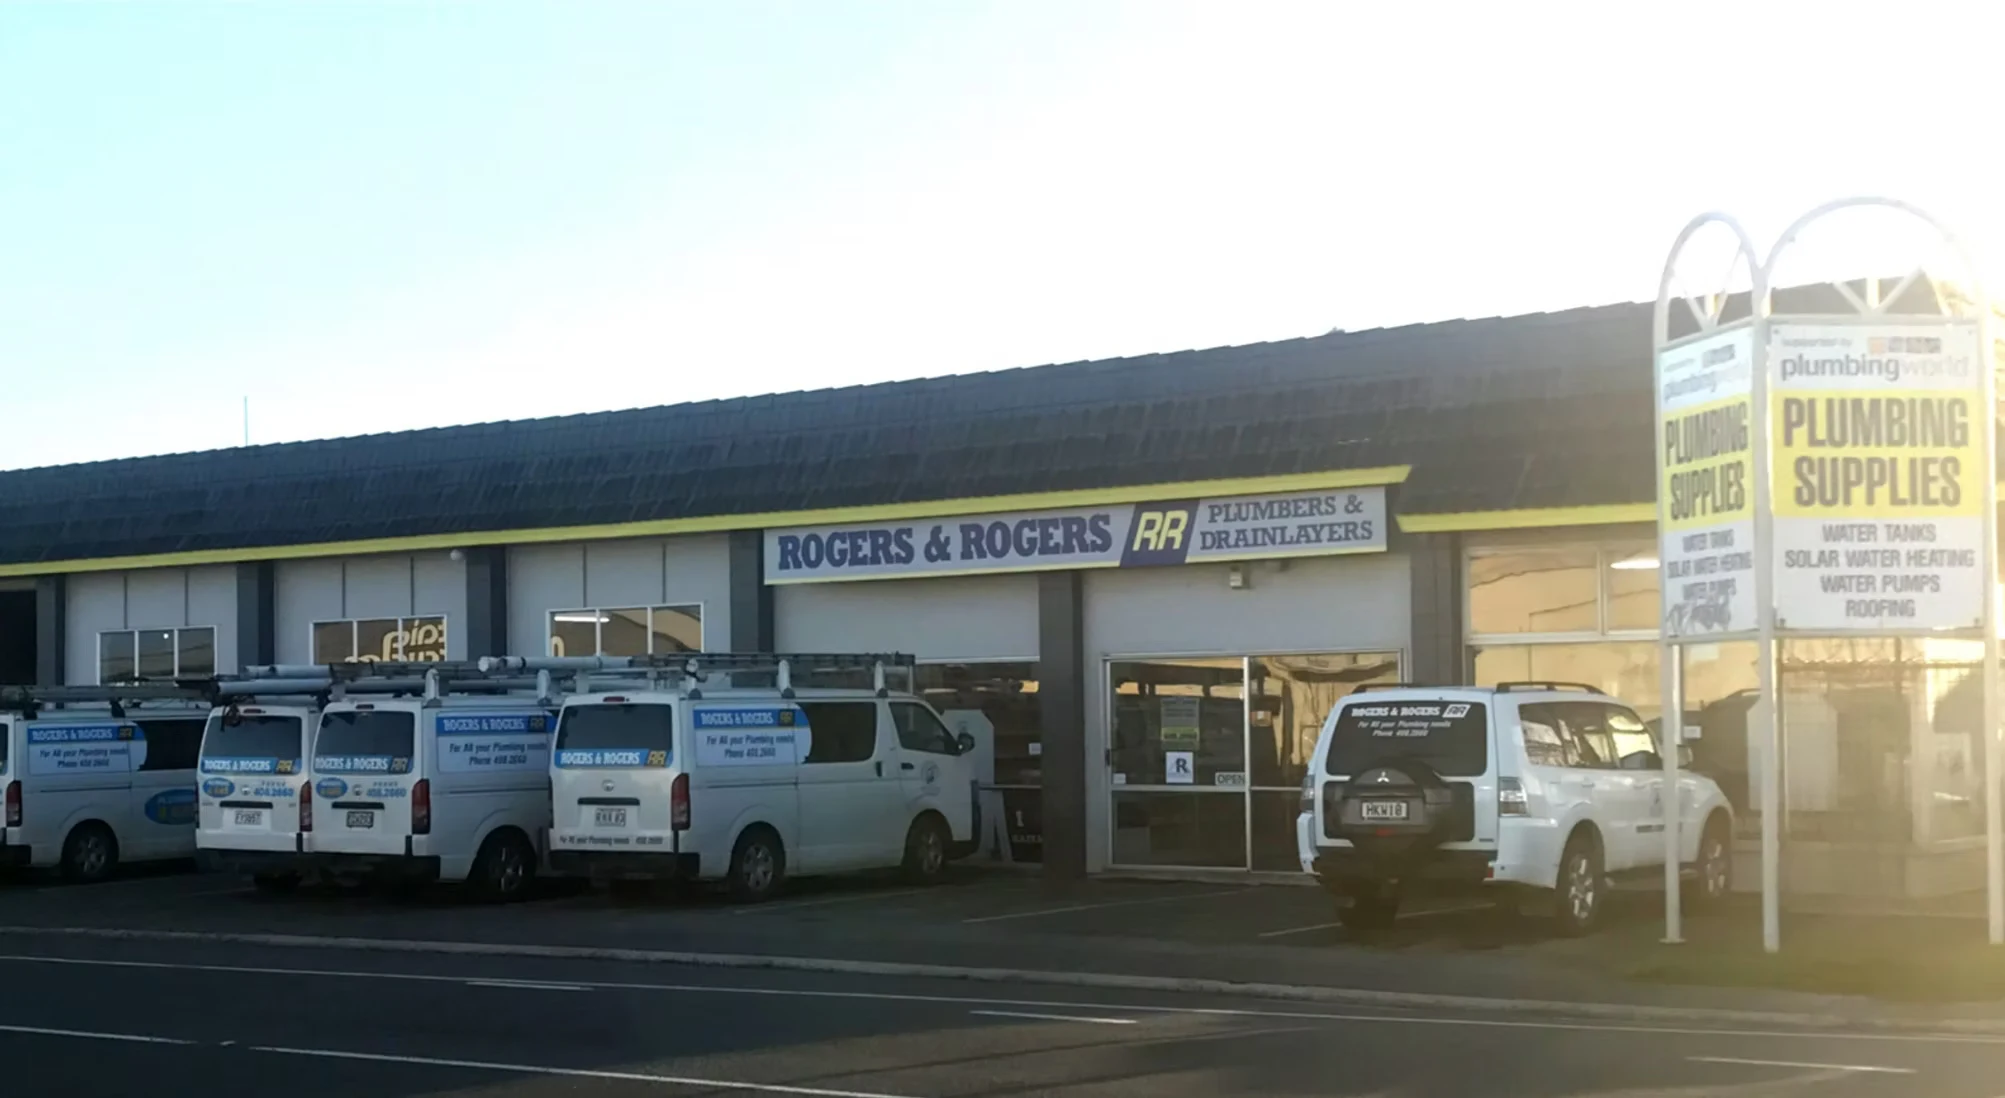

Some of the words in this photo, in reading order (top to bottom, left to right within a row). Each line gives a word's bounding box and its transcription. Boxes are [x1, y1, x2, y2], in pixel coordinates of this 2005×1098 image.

[1783, 397, 1968, 448] PLUMBING
[1665, 402, 1748, 467] PLUMBING
[1671, 460, 1745, 520] SUPPLIES
[1794, 455, 1961, 507] SUPPLIES
[1208, 496, 1336, 523] PLUMBERS
[1344, 494, 1363, 514] &
[1132, 510, 1189, 551] RR
[1200, 521, 1373, 551] DRAINLAYERS
[1822, 524, 1877, 542] WATER
[1884, 524, 1937, 542] TANKS
[778, 528, 914, 570] ROGERS
[924, 525, 951, 563] &
[959, 514, 1113, 560] ROGERS
[1785, 550, 1839, 568] SOLAR
[1845, 549, 1900, 568] WATER
[1906, 549, 1975, 567] HEATING
[1820, 574, 1876, 593] WATER
[1881, 575, 1941, 592] PUMPS
[1845, 599, 1916, 617] ROOFING
[700, 712, 733, 725] ROGERS
[742, 712, 774, 724] ROGERS
[1351, 707, 1389, 717] ROGERS
[1400, 707, 1440, 716] ROGERS
[443, 719, 480, 731] ROGERS
[490, 719, 525, 730] ROGERS
[32, 730, 68, 741] ROGERS
[77, 728, 113, 739] ROGERS
[240, 760, 270, 771] ROGERS
[354, 758, 388, 770] ROGERS
[560, 752, 593, 764] ROGERS
[603, 752, 640, 764] ROGERS
[1175, 758, 1189, 773] R
[1216, 774, 1246, 784] OPEN
